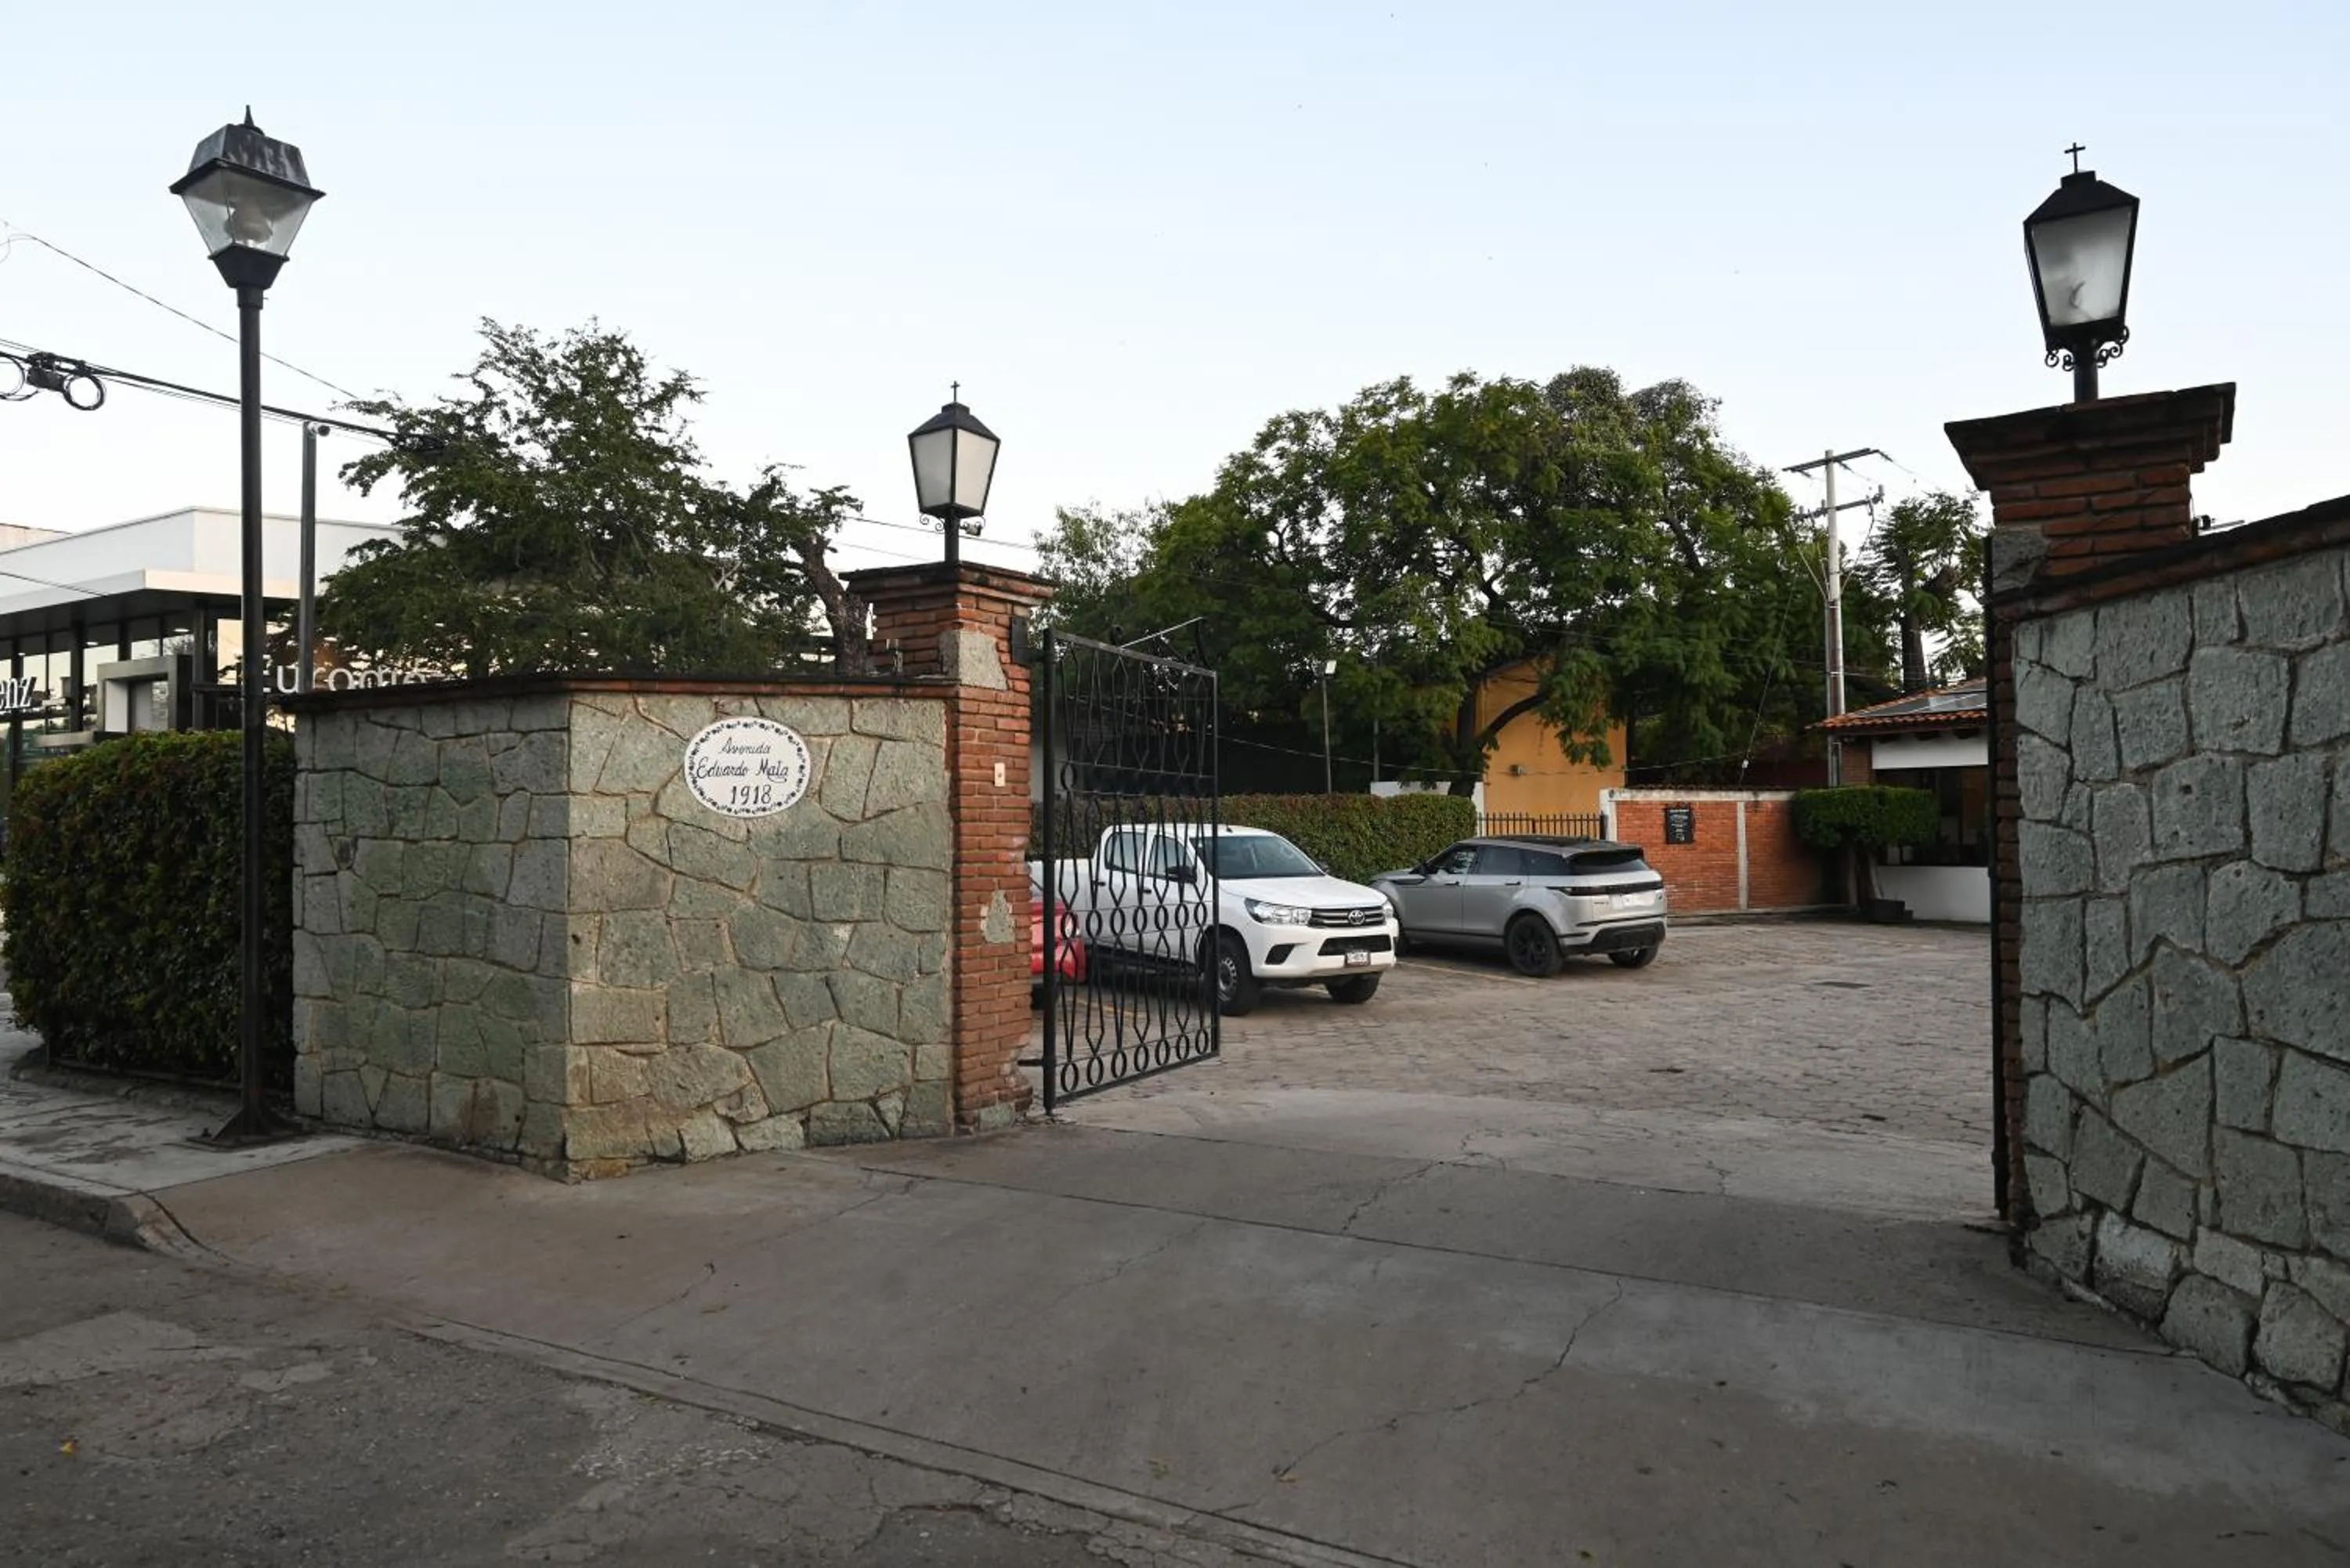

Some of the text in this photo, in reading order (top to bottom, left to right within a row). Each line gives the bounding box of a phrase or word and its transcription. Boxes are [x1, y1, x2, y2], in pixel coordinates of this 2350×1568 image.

[718, 737, 771, 754] Avenida
[696, 757, 789, 783] Eduardo Mata
[731, 784, 772, 806] 1918
